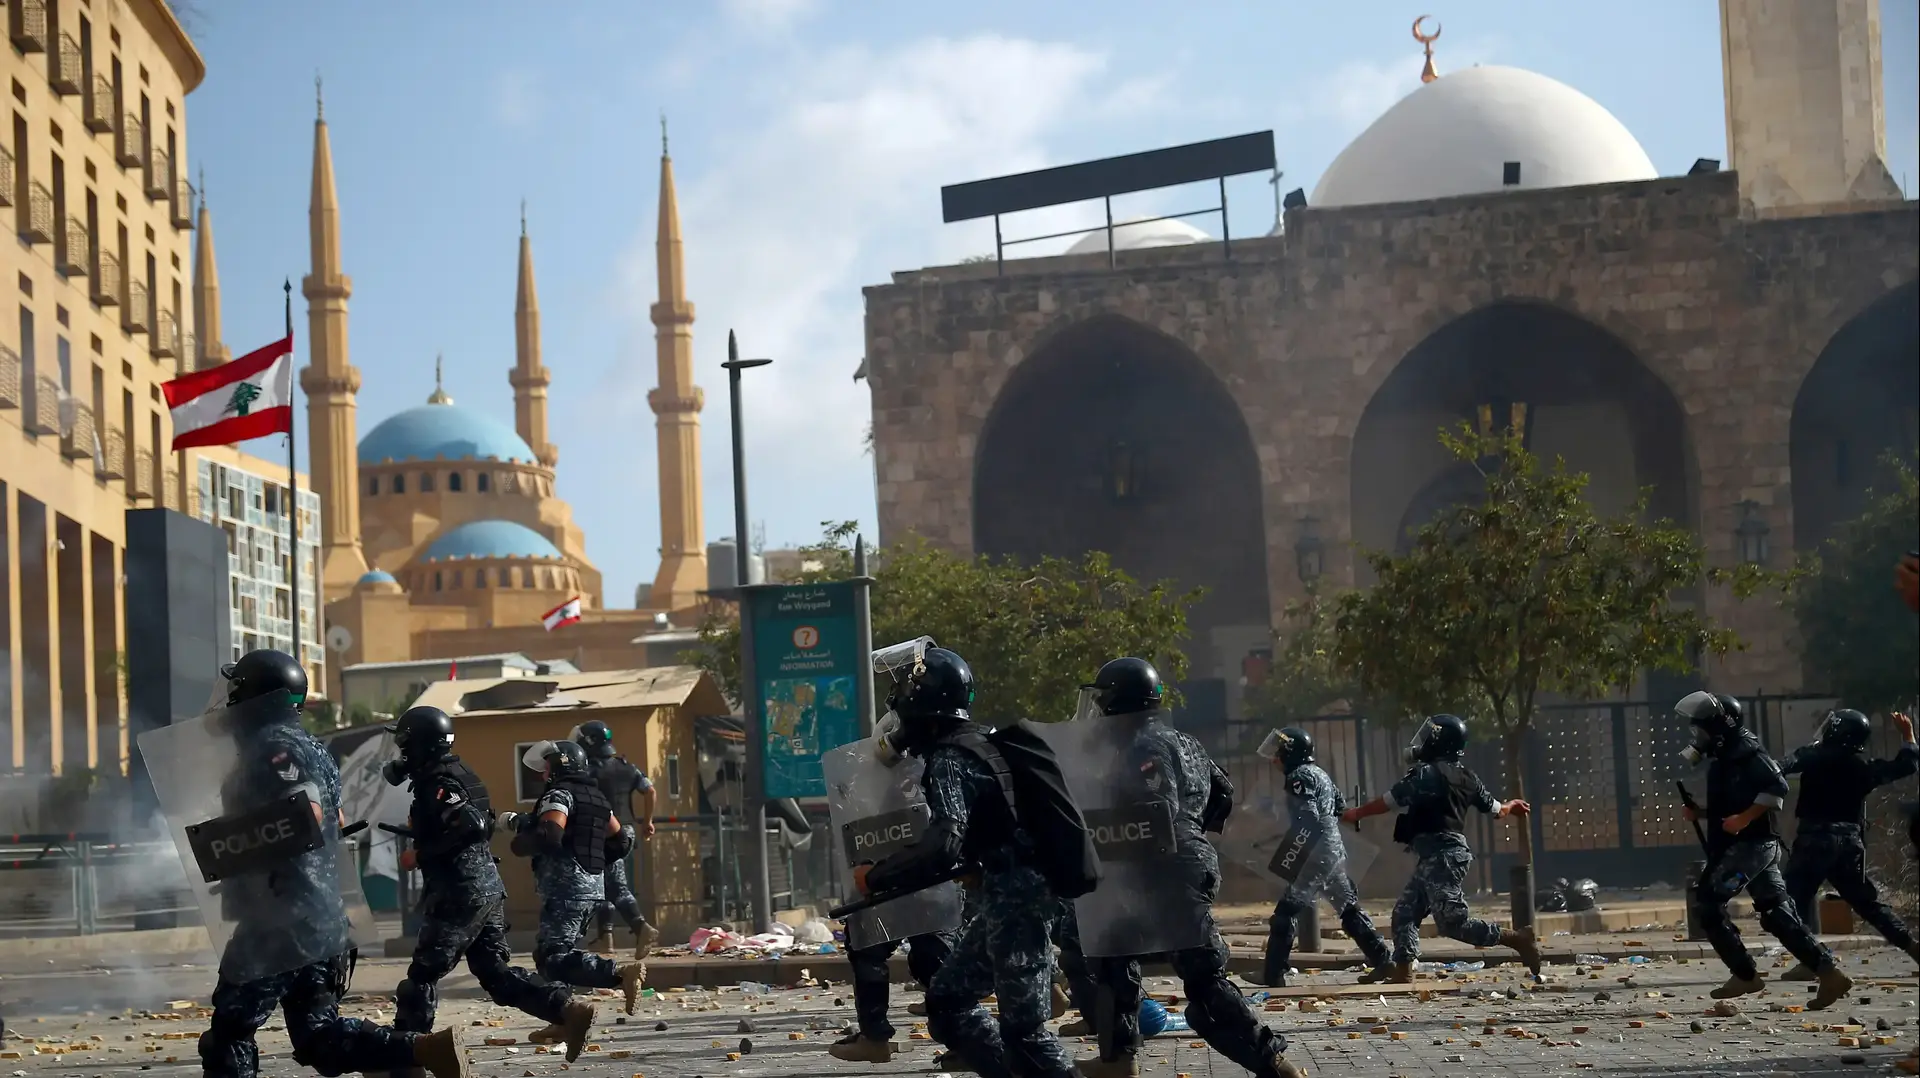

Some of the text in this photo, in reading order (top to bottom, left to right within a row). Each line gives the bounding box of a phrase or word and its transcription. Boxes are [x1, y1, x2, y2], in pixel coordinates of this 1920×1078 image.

[780, 660, 835, 671] INFORMATION
[210, 818, 295, 859] POLICE
[854, 822, 913, 851] POLICE
[1280, 827, 1312, 870] POLICE
